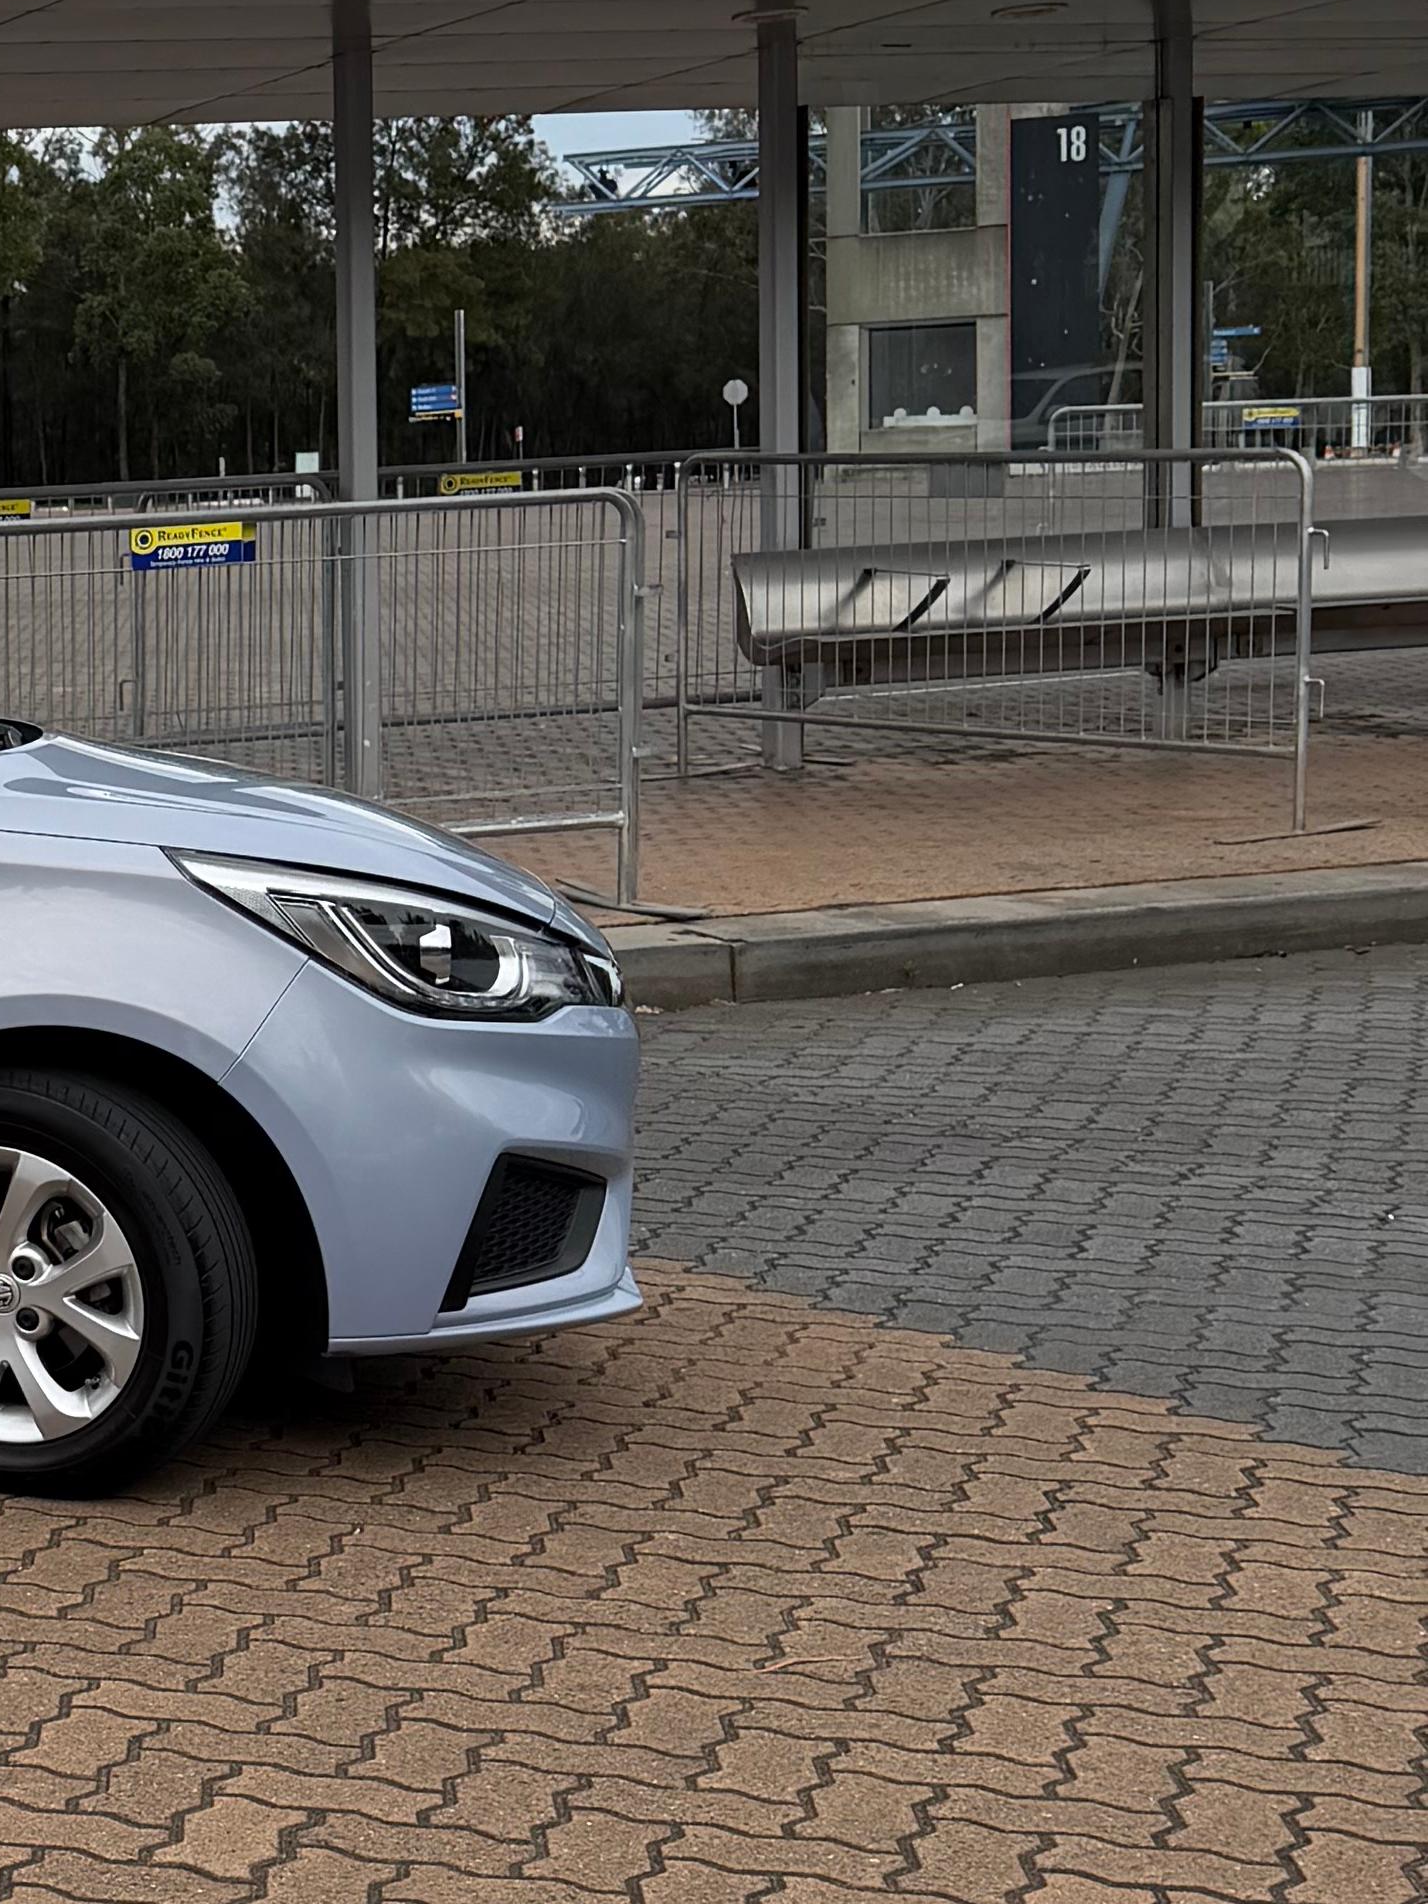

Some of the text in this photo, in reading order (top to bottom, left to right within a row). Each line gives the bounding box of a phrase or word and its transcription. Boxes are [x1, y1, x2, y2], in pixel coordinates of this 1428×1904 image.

[1056, 125, 1087, 162] 18
[157, 543, 230, 560] 1800 177 000
